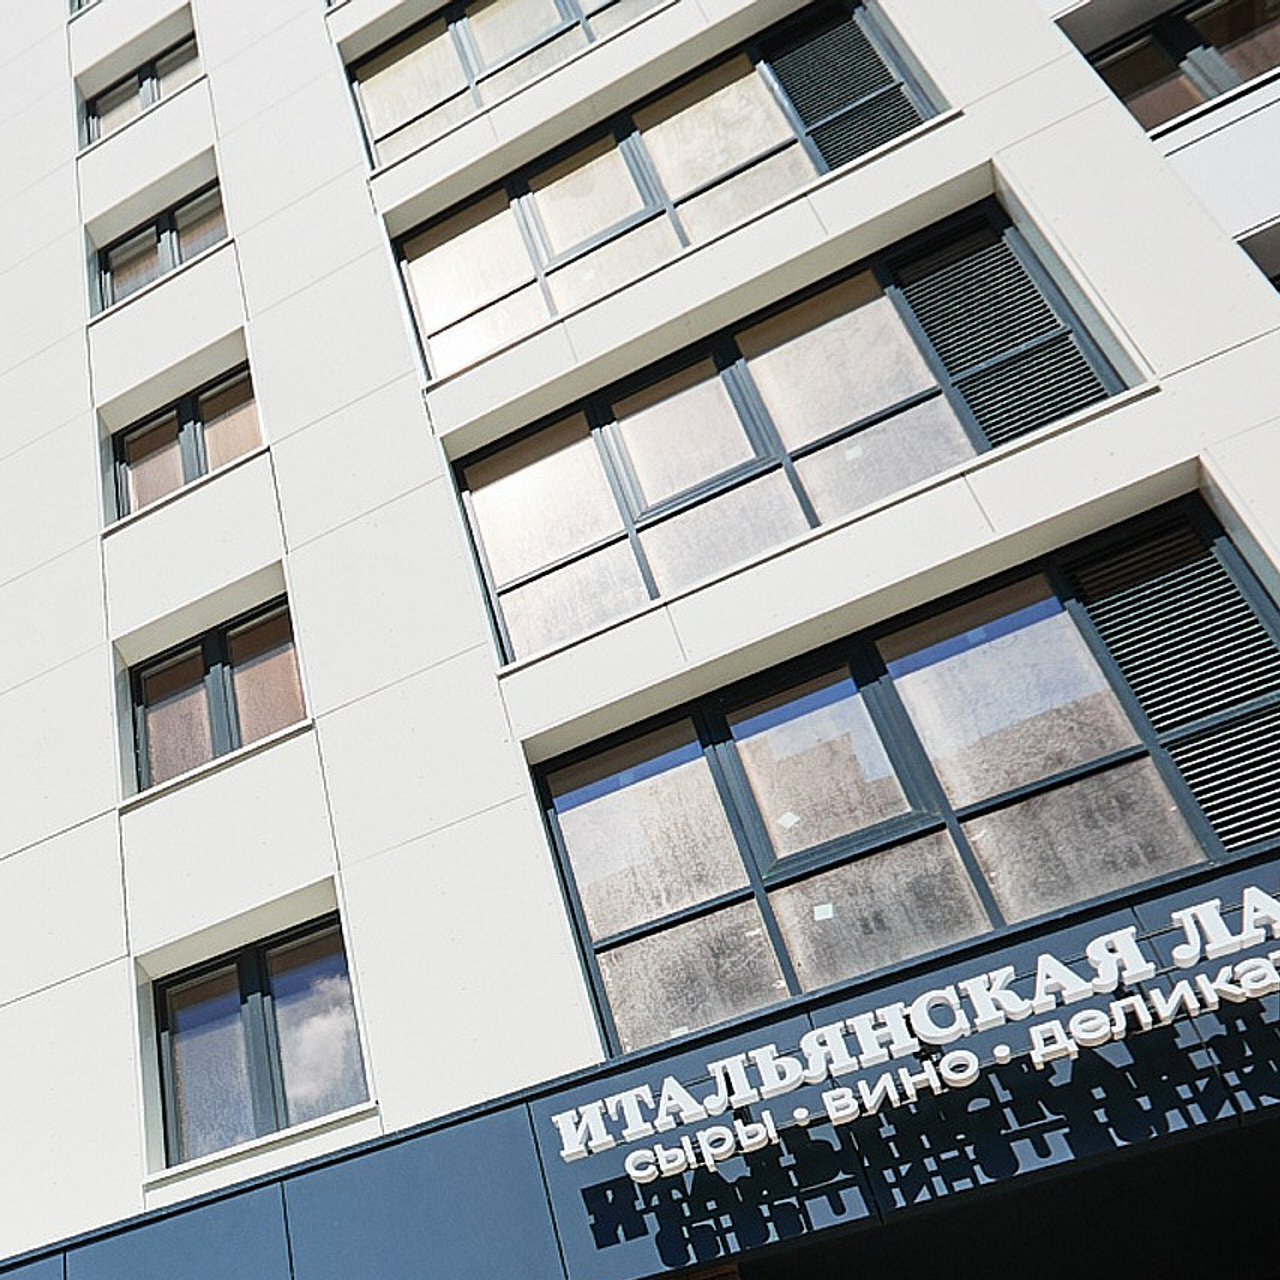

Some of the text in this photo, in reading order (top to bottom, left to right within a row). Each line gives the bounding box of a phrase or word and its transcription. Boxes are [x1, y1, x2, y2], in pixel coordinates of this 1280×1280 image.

[551, 926, 1156, 1163] ИТАЛЬЯНСКАЯ
[624, 1110, 778, 1183] сыры
[821, 1049, 980, 1122] вино
